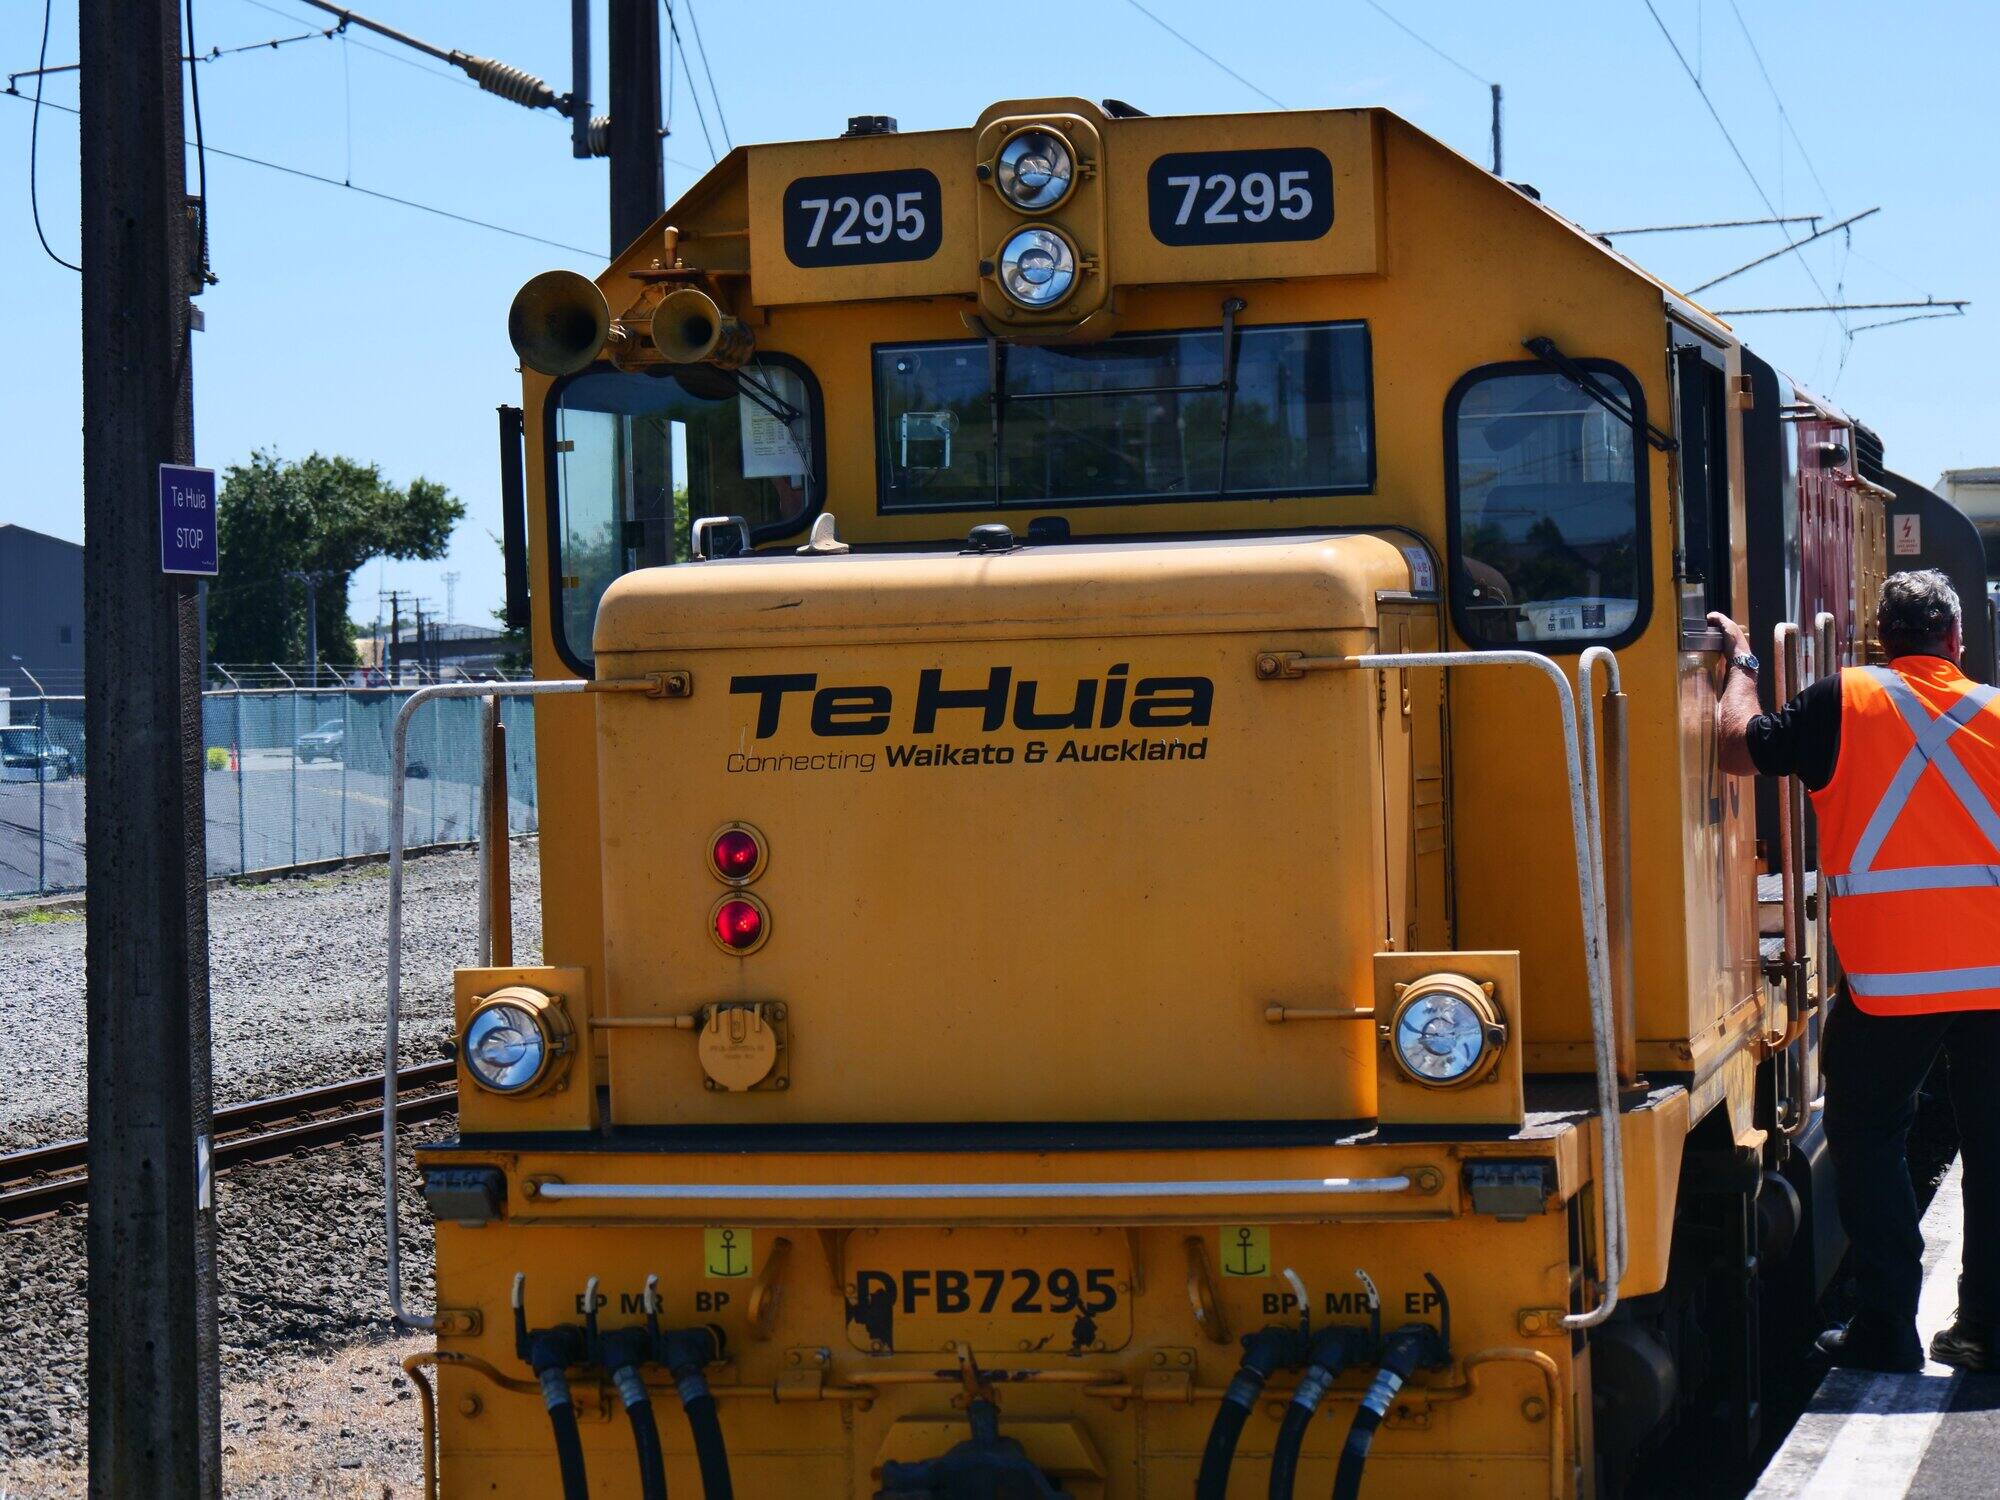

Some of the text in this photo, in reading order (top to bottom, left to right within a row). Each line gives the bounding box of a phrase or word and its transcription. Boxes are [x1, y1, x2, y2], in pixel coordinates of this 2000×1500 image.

[1167, 170, 1314, 226] 7295
[800, 191, 927, 249] 7295
[172, 486, 206, 509] Te Huia
[176, 528, 203, 548] STOP
[729, 663, 1215, 740] Te Huia
[726, 737, 1208, 773] Connecting Waikato & Auckland
[696, 1291, 730, 1313] BP
[856, 1268, 1118, 1314] DFB7295
[1262, 1292, 1441, 1314] BP MR EP
